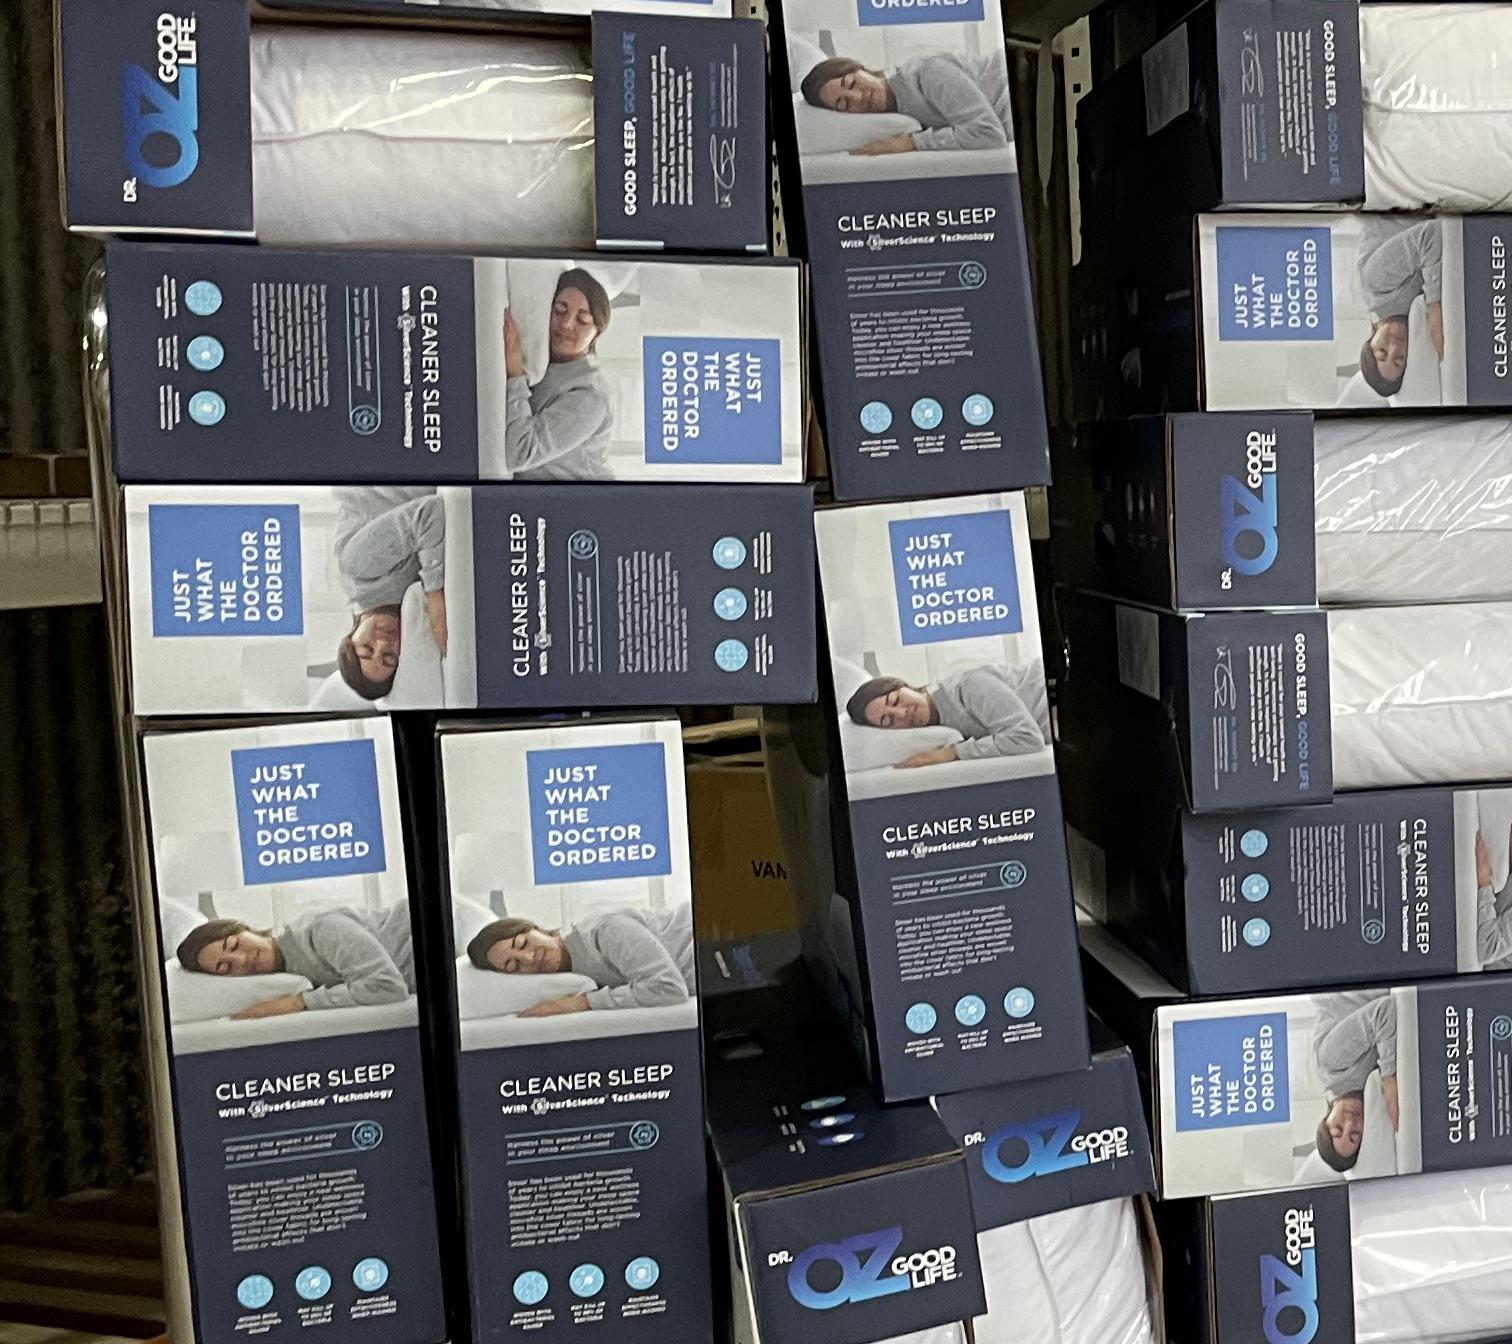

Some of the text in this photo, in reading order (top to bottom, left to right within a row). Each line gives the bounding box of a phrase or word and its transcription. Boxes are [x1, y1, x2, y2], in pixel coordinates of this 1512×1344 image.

[156, 13, 178, 83] GOOD
[176, 17, 197, 65] LIFE
[122, 63, 199, 187] OZ
[837, 207, 996, 232] CLEANER SLEEP
[543, 765, 598, 785] JUST
[544, 784, 611, 805] WHAT
[545, 807, 589, 826] THE
[882, 808, 1036, 843] CLEANER SLEEP
[548, 824, 641, 846] DOCTOR
[549, 843, 656, 867] ORDERED
[215, 1063, 395, 1101] CLEANER SLEEP
[500, 1064, 673, 1098] CLEANER SLEEP
[1242, 1037, 1258, 1113] DOCTOR
[1259, 1024, 1275, 1112] ORDERED
[1190, 1074, 1205, 1118] JUST
[1207, 1063, 1223, 1117] WHAT
[1226, 1079, 1240, 1115] THE
[981, 1109, 1090, 1184] OZ
[1070, 1126, 1129, 1153] GOOD
[1089, 1141, 1130, 1163] LIFE
[1284, 1208, 1302, 1266] GOOD
[1298, 1208, 1315, 1249] LIFE
[787, 1226, 912, 1310] OZ
[891, 1245, 957, 1276] GOOD
[910, 1264, 958, 1289] LIFE
